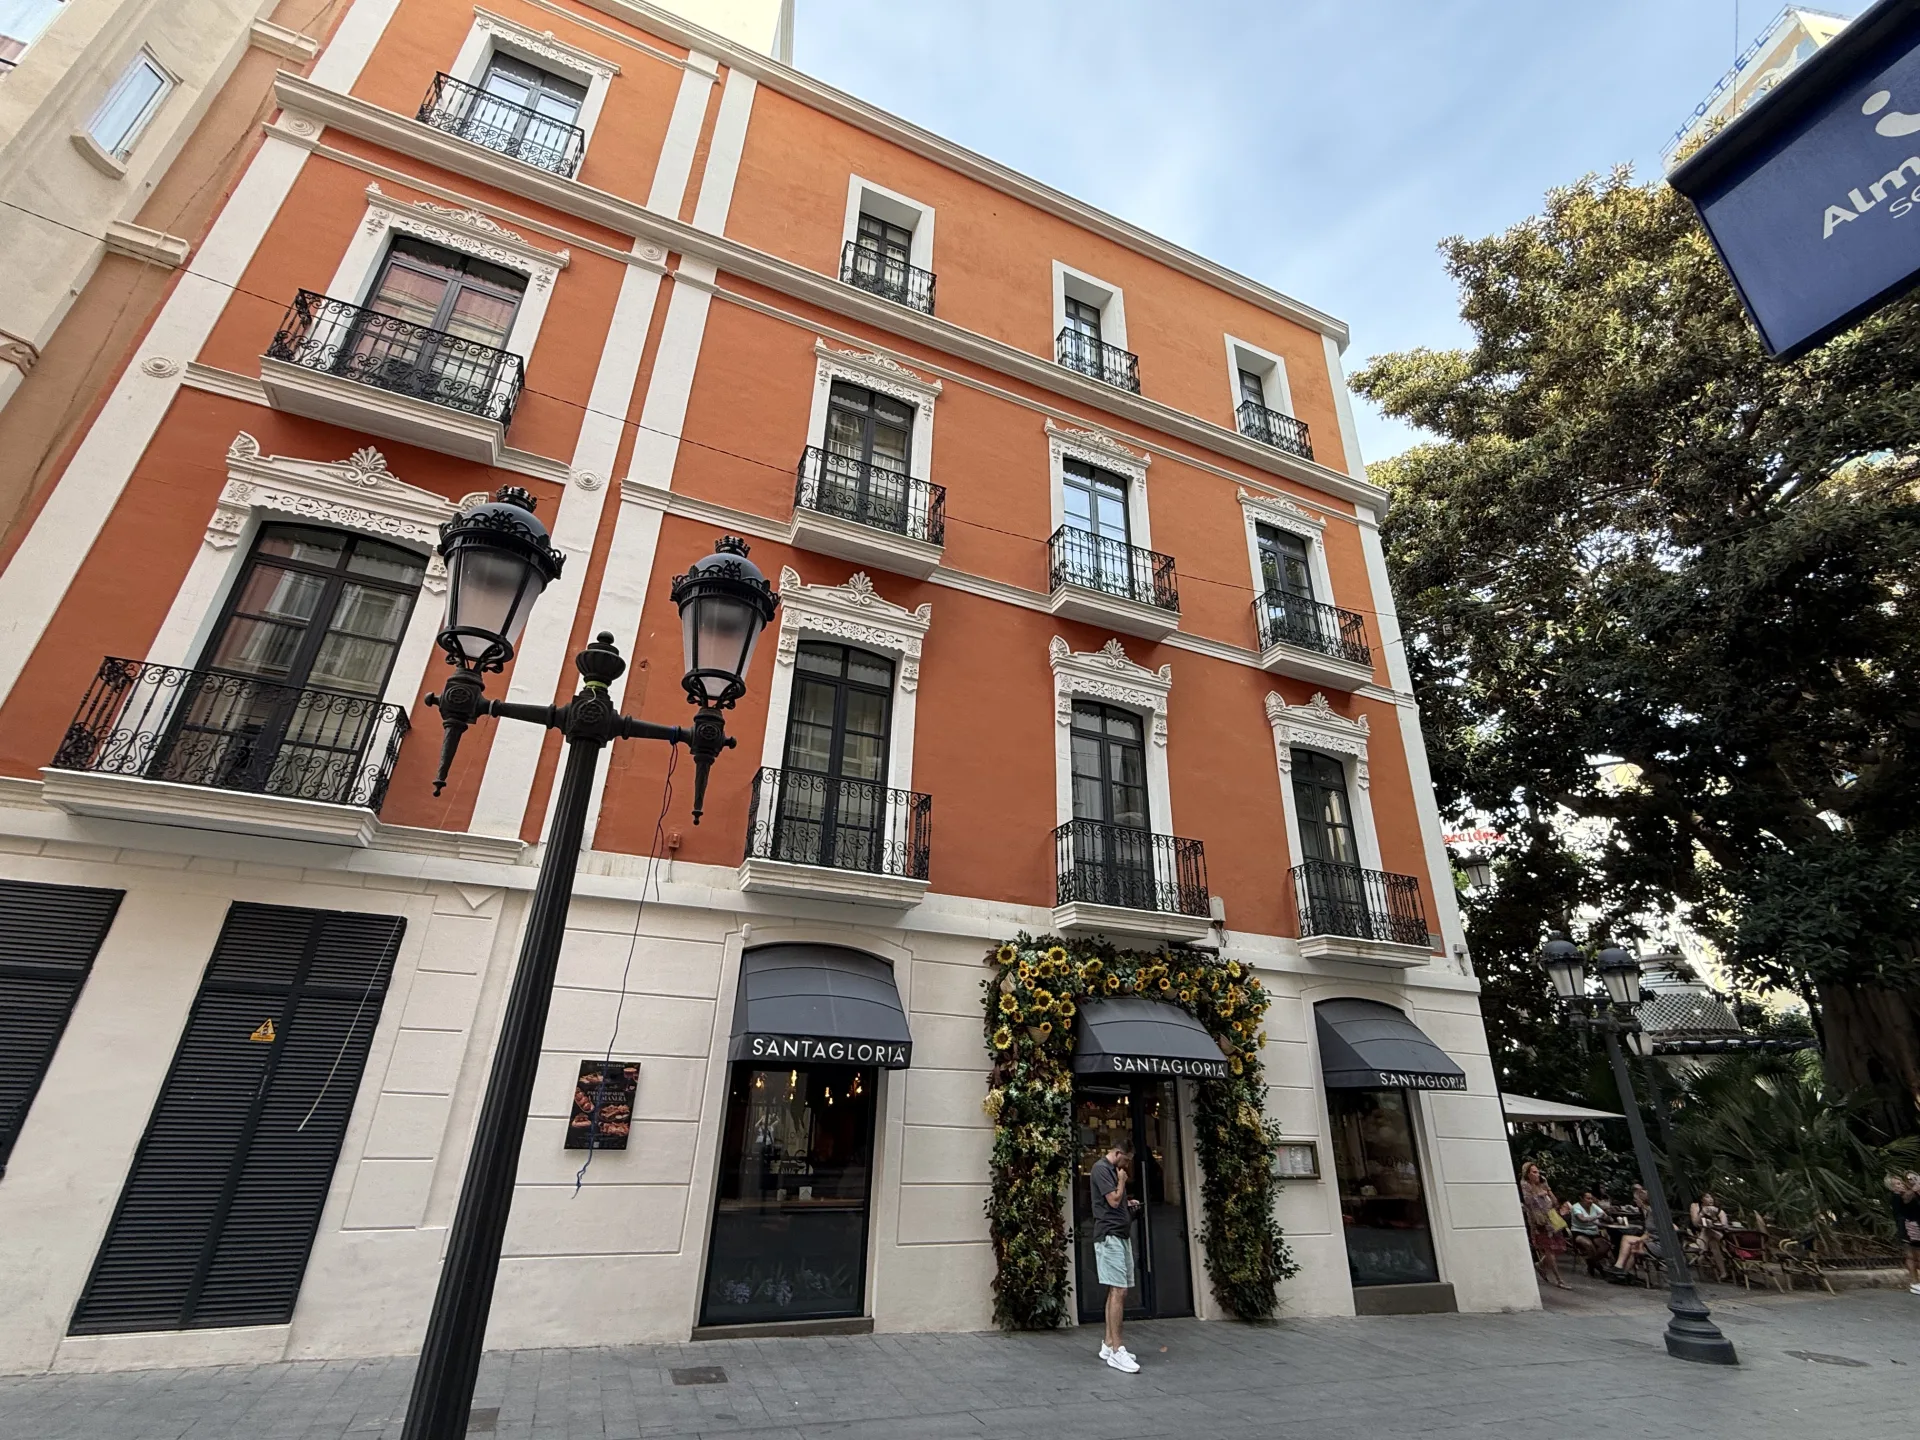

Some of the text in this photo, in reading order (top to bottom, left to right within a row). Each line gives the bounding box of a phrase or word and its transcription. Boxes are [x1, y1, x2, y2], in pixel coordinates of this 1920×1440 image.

[1675, 37, 1769, 140] HOTEL
[752, 1038, 905, 1063] SANTAGLORIA
[1113, 1056, 1226, 1078] SANTAGLORIA
[1379, 1072, 1465, 1089] SANTAGLORIA
